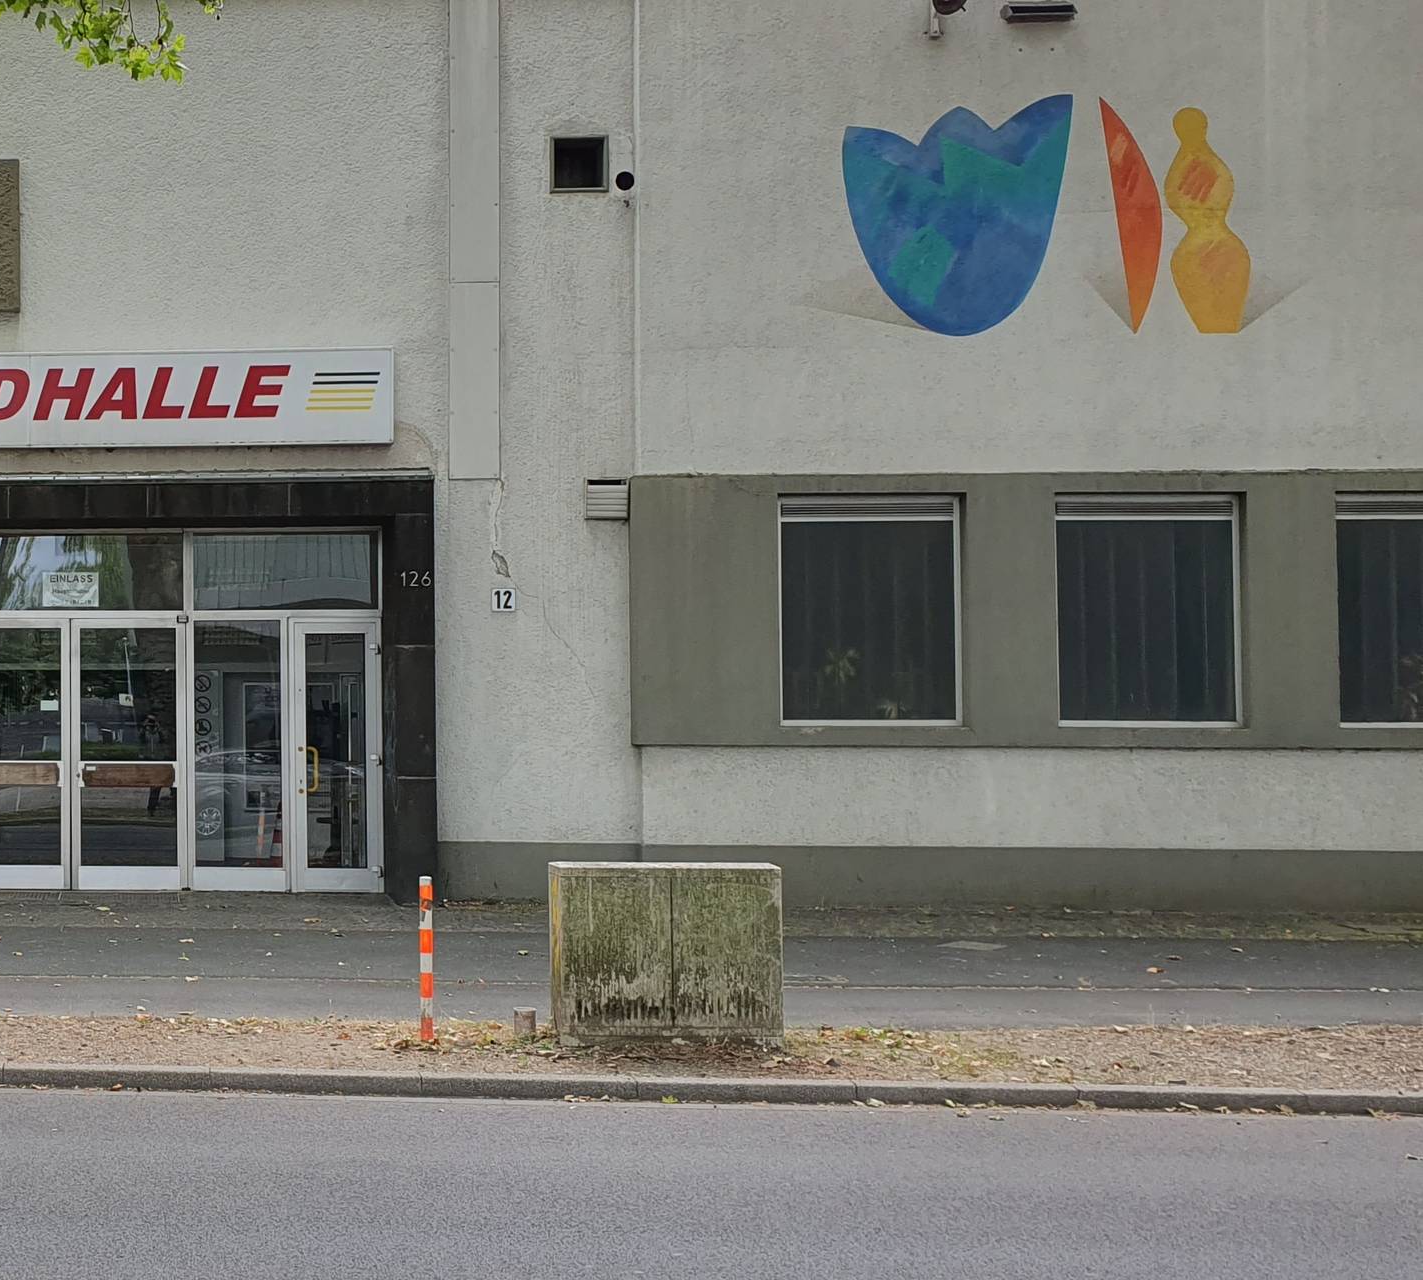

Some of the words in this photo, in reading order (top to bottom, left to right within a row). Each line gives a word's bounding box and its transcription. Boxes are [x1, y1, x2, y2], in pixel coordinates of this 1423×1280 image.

[49, 574, 93, 583] EINLASS
[400, 571, 432, 587] 126
[493, 590, 513, 609] 12
